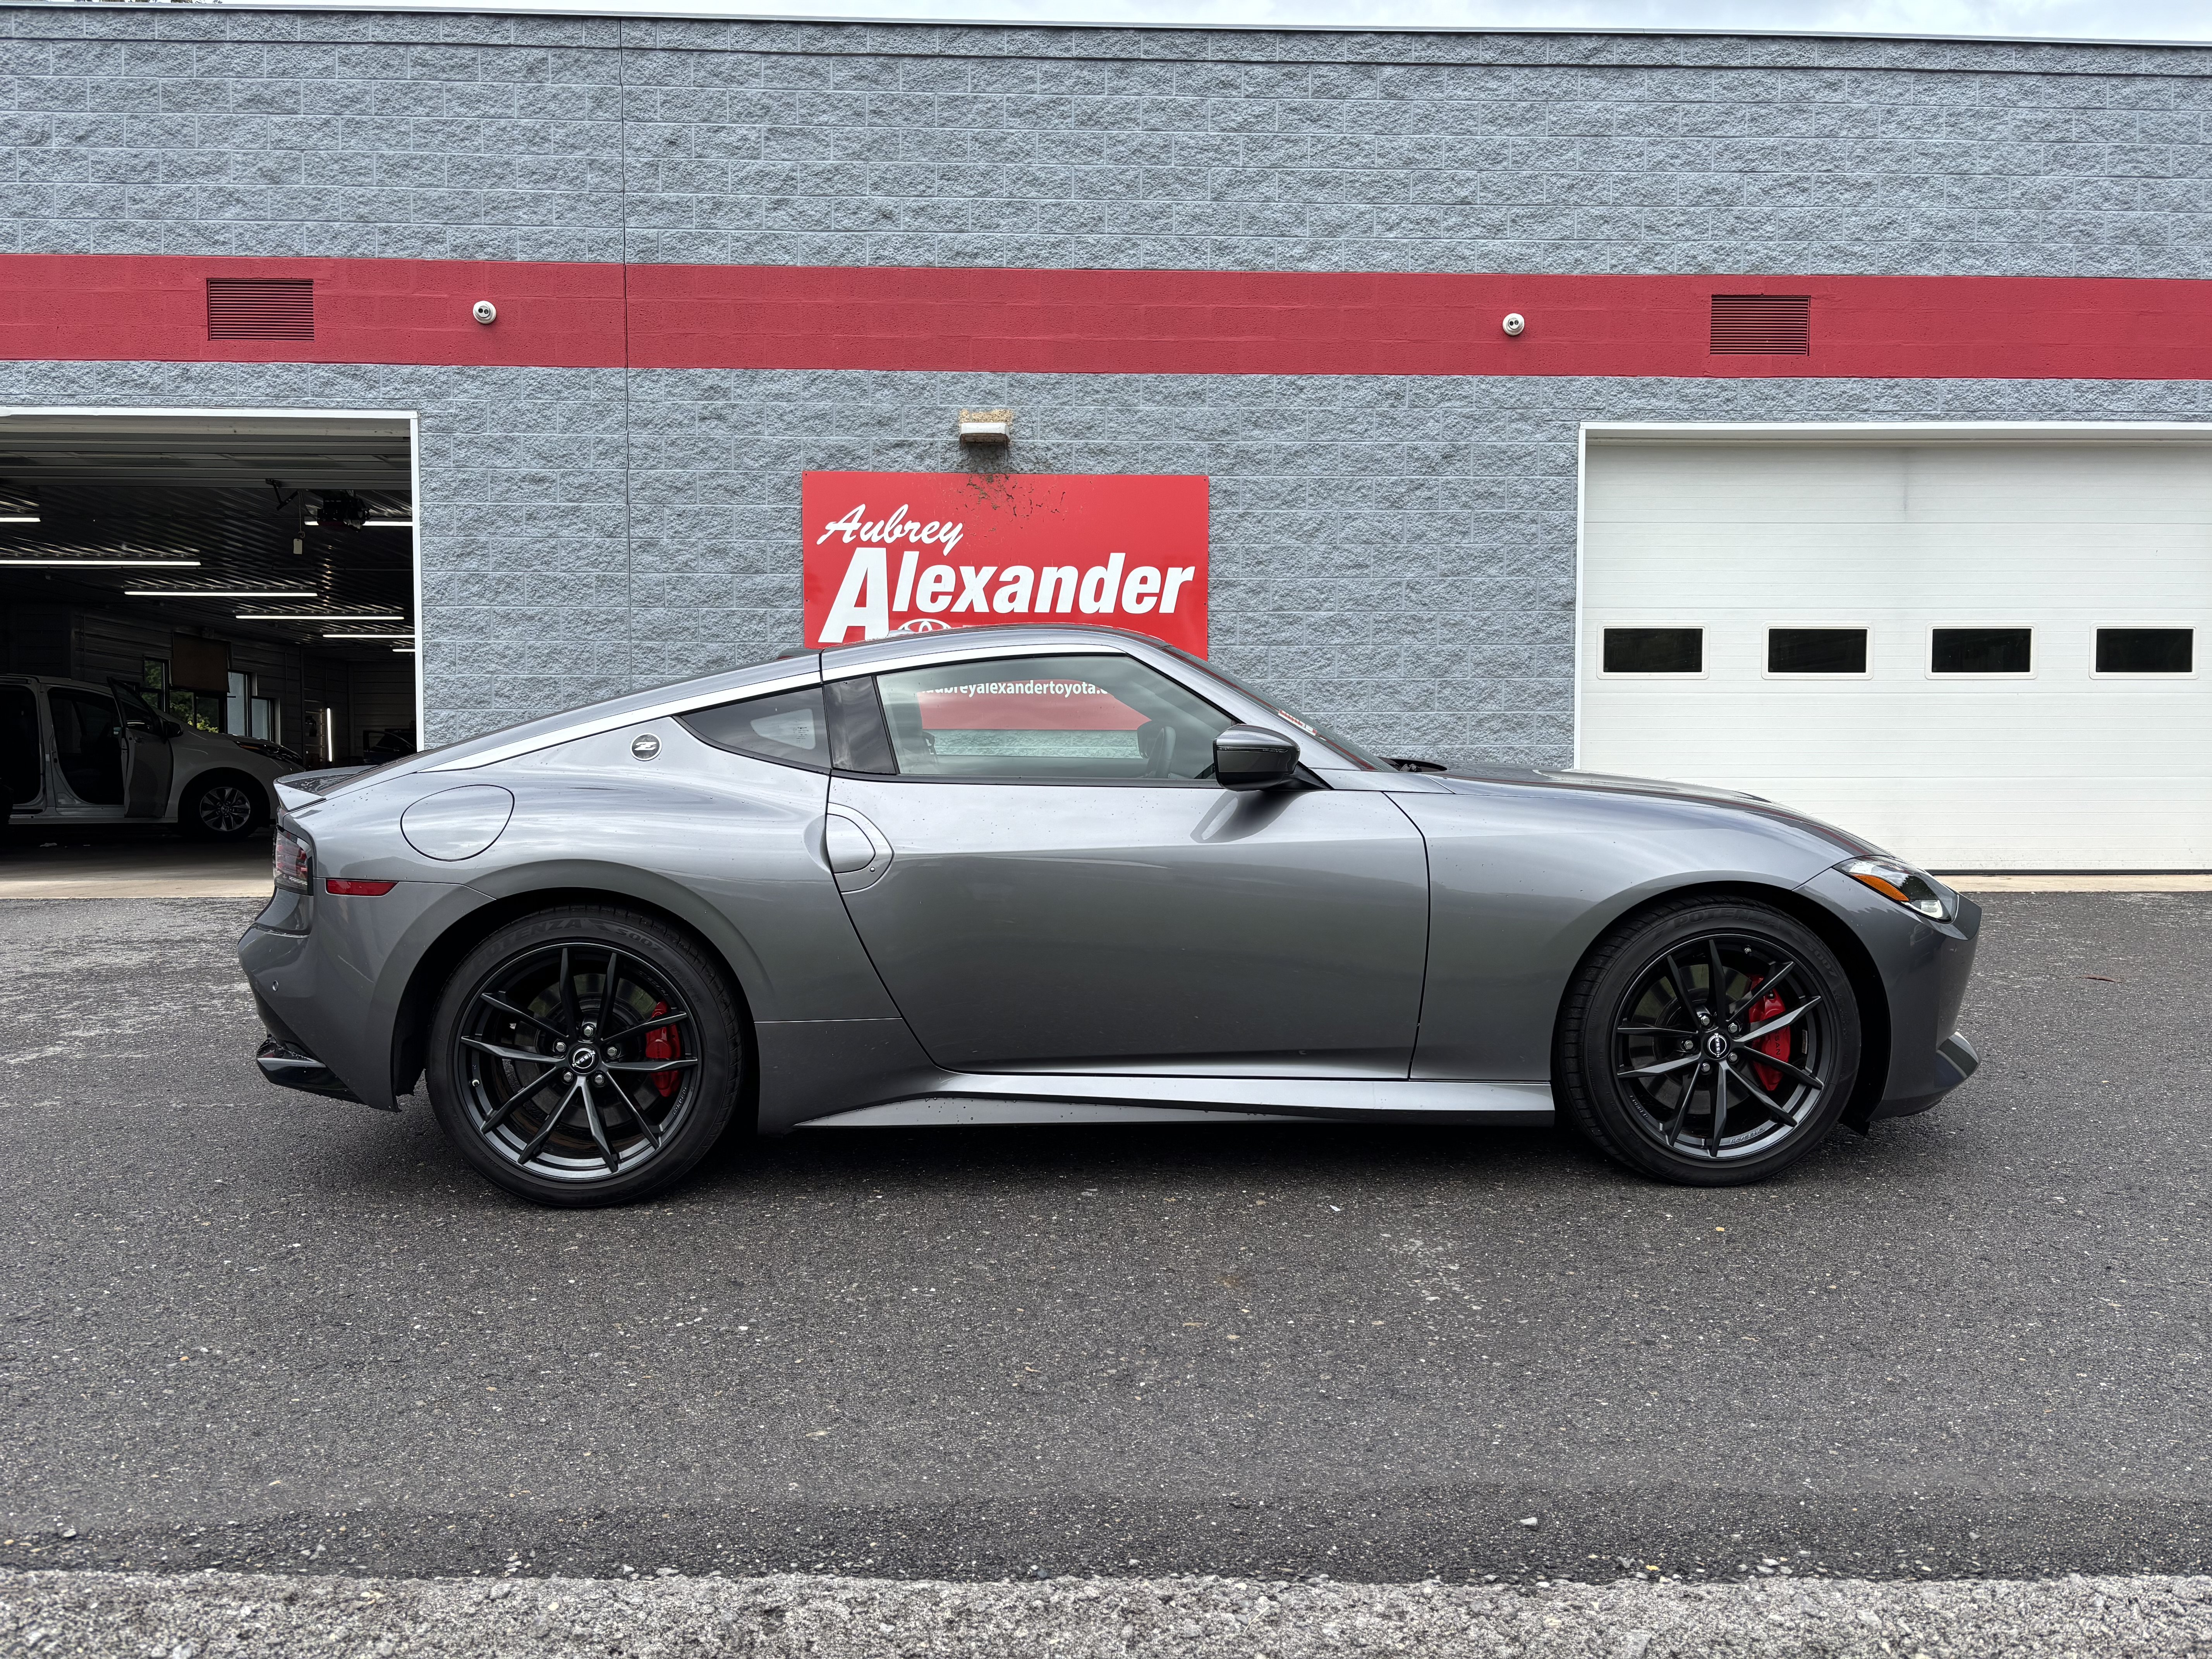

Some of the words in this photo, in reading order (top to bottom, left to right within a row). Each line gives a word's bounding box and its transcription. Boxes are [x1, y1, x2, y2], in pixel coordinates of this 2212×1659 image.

[816, 504, 963, 556] Aubrey
[818, 547, 1195, 643] Alexander
[1674, 908, 1781, 930] POTENZA
[572, 1050, 596, 1067] NISSAN
